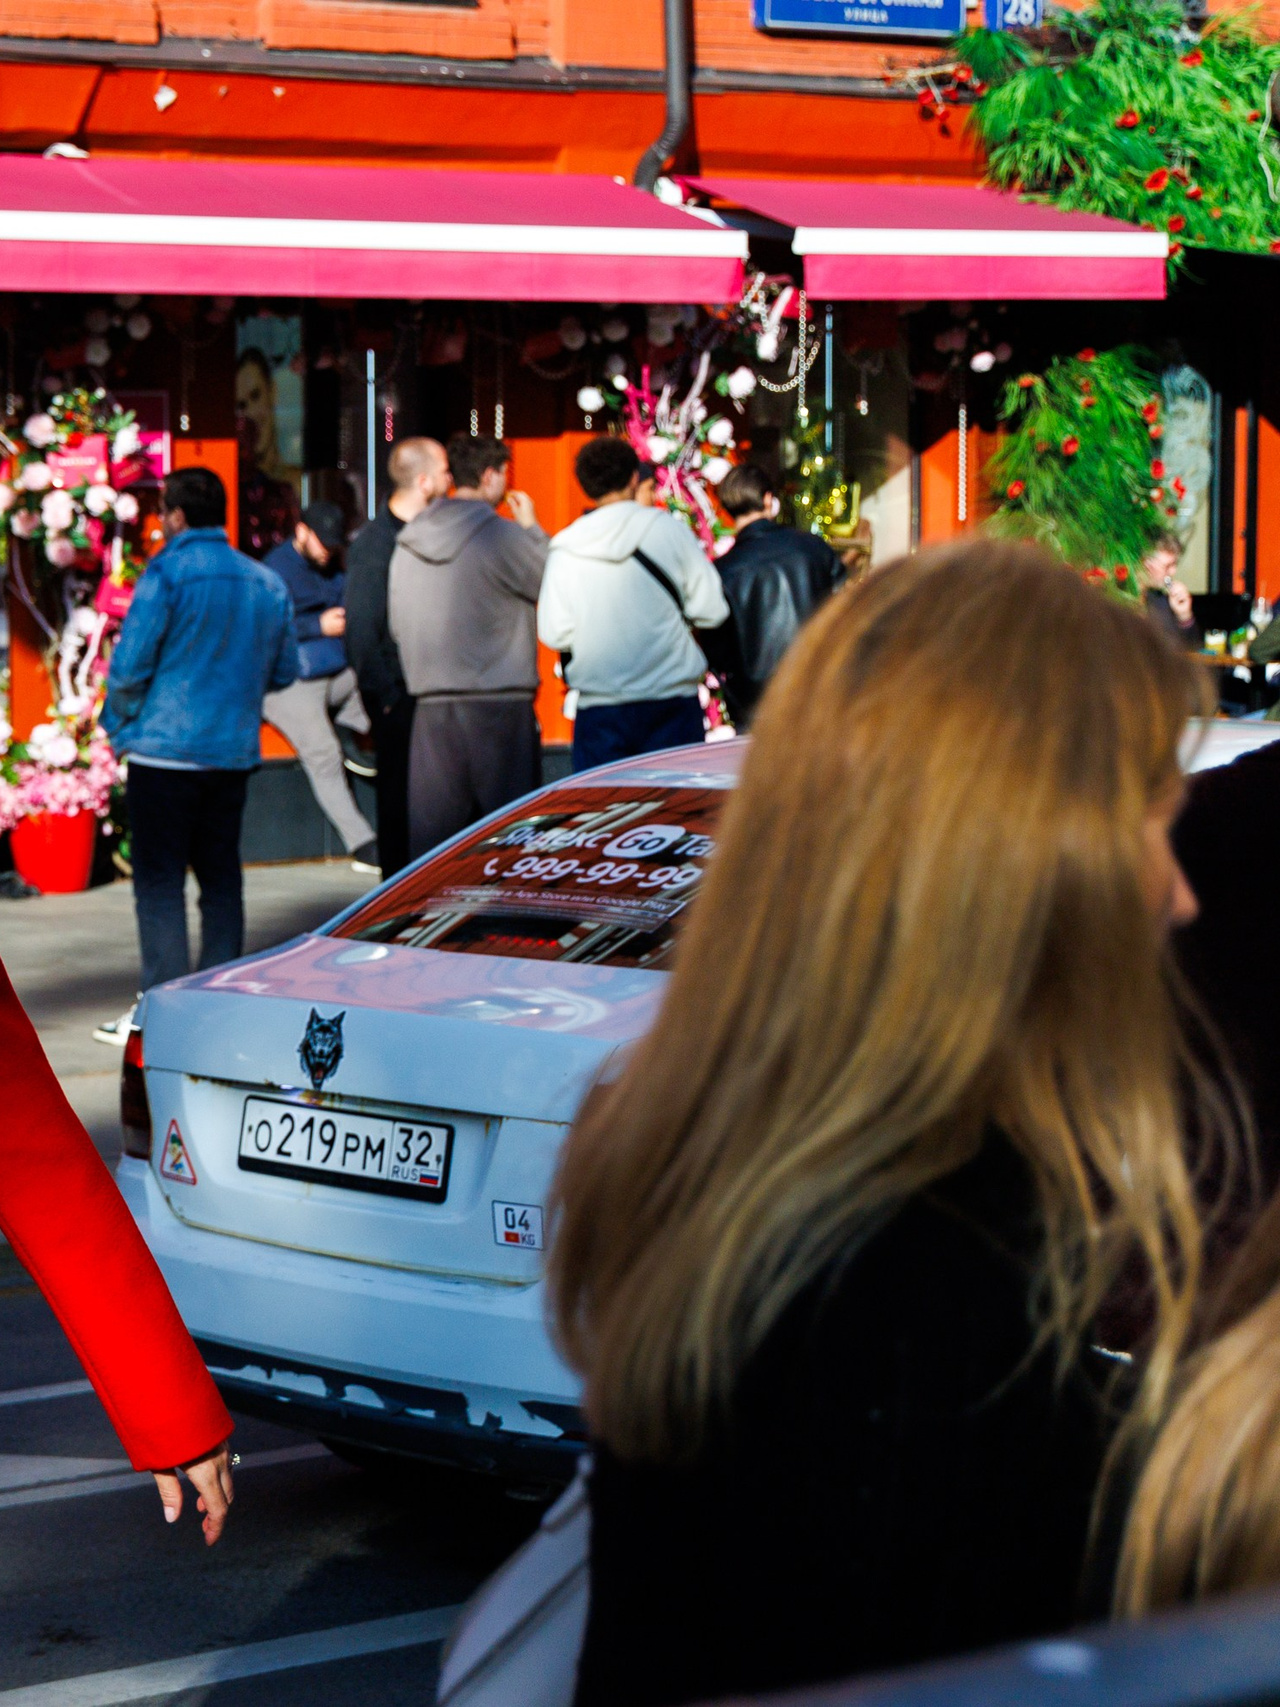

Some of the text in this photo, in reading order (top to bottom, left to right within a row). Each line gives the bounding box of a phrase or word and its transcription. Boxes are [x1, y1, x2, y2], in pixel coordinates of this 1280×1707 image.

[1004, 0, 1036, 25] 28
[497, 826, 613, 851] Яндекс
[502, 856, 703, 890] 999-99-99
[596, 894, 641, 908] Google
[640, 899, 672, 911] Play
[396, 1127, 433, 1167] 32
[391, 1165, 418, 1182] RUS
[504, 1207, 530, 1231] 04
